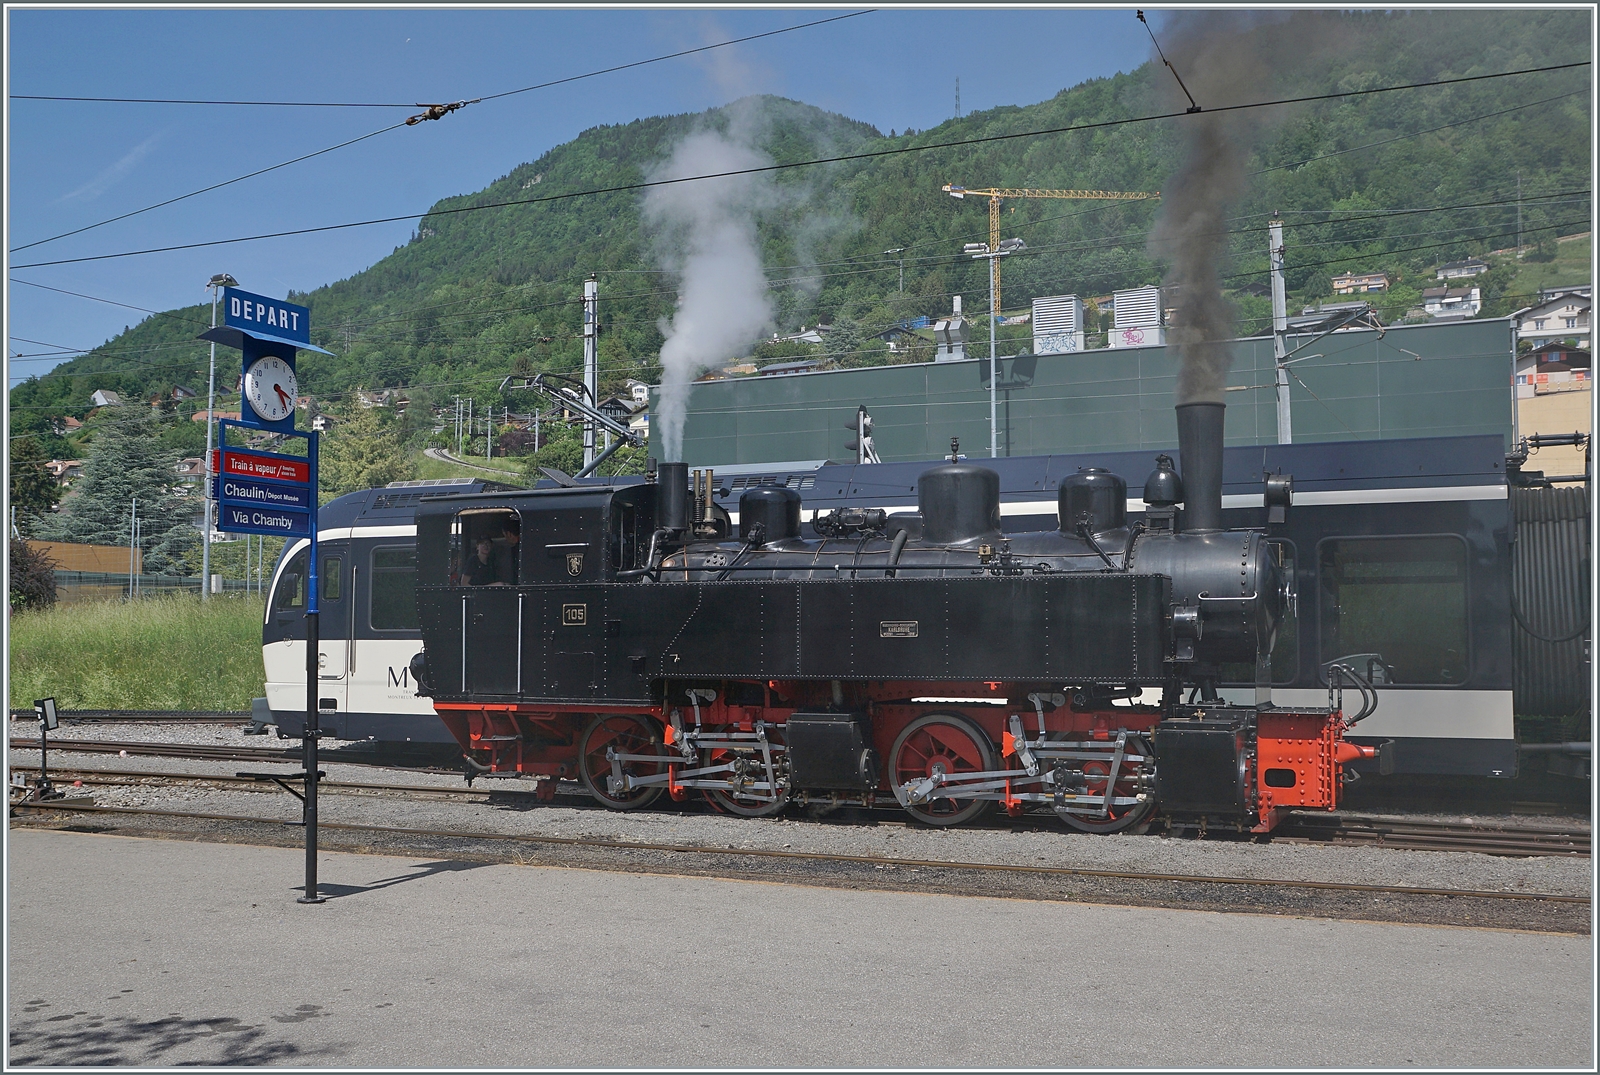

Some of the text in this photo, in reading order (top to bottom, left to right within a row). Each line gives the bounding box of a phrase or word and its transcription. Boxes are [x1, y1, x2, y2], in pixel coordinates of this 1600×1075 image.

[231, 297, 299, 331] DEPART
[256, 369, 263, 377] 10
[231, 458, 248, 471] Train
[248, 461, 254, 472] à
[255, 464, 277, 476] vapeur
[232, 510, 293, 530] Via Chamby
[565, 609, 584, 620] 105
[387, 666, 408, 688] M
